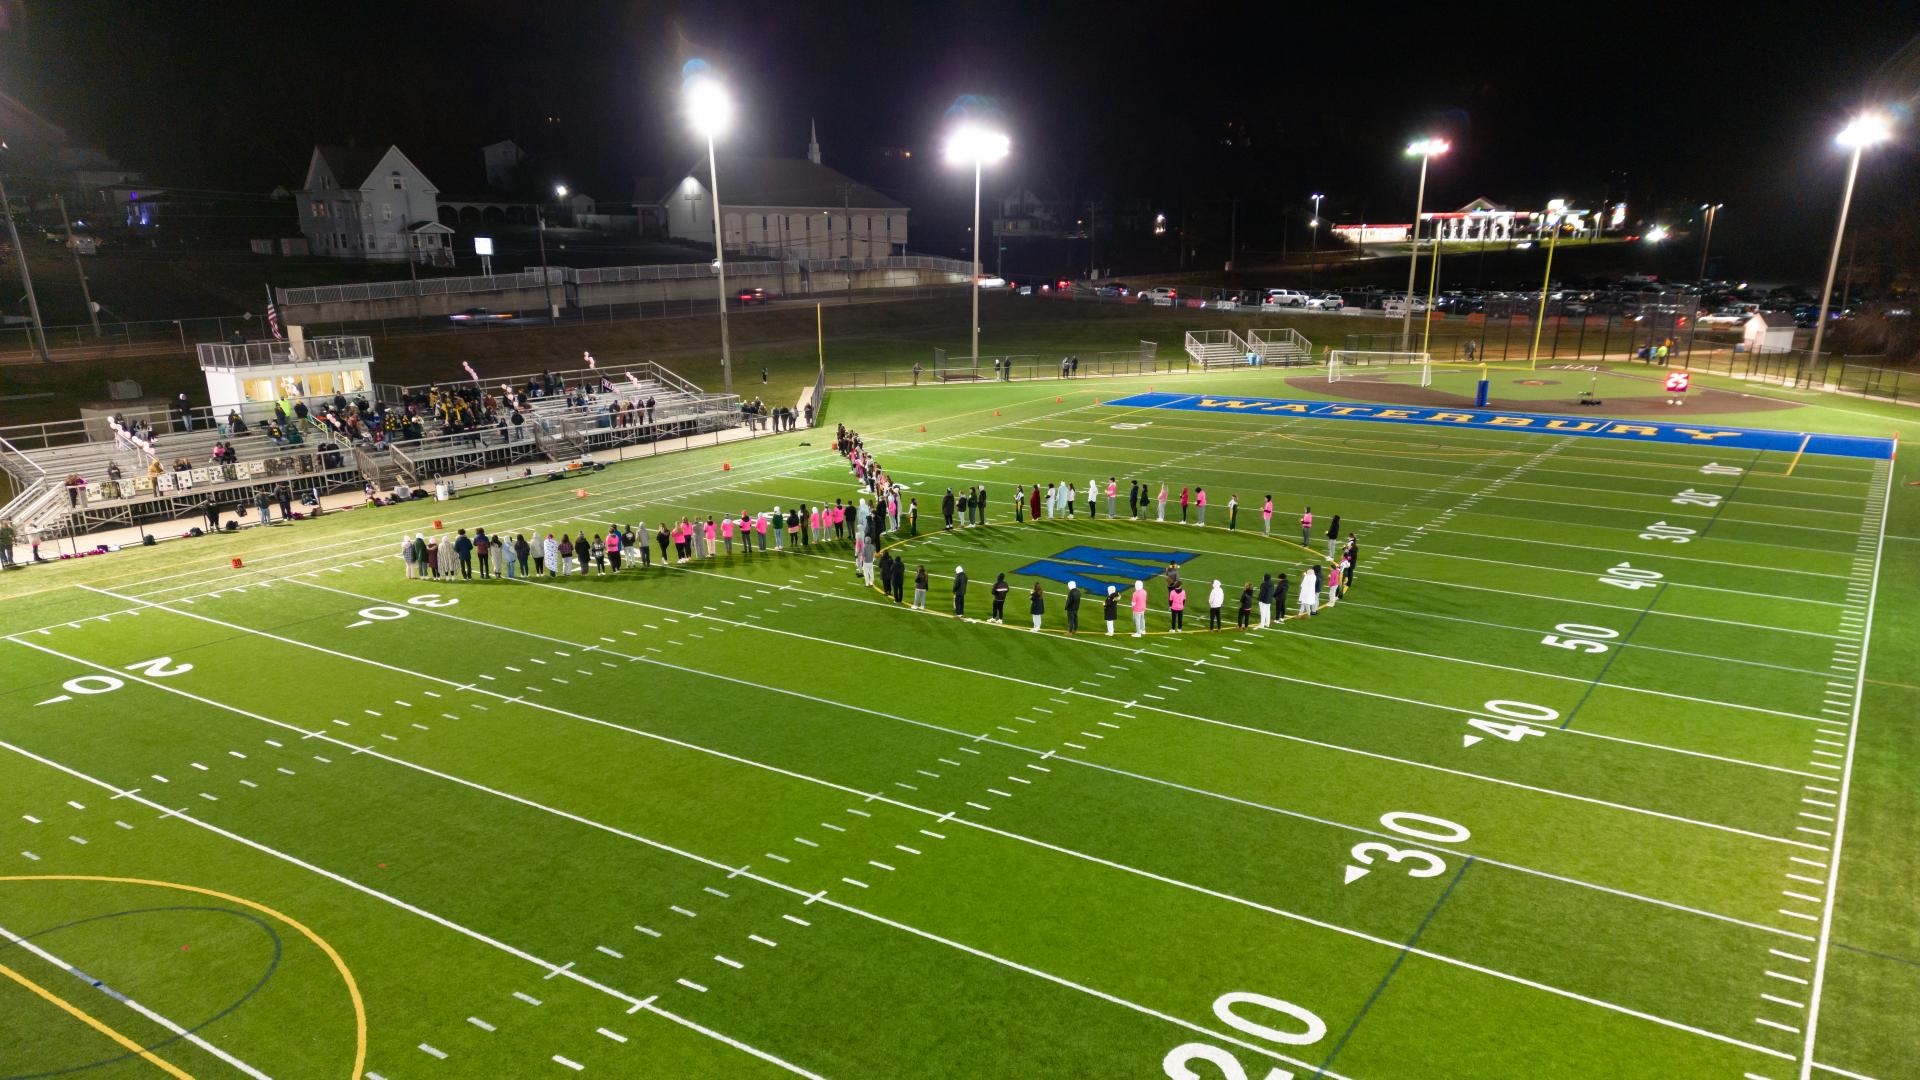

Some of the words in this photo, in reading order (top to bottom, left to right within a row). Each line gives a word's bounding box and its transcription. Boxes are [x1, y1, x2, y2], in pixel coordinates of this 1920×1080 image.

[1667, 373, 1689, 388] 25
[1199, 398, 1743, 440] WATERBURY
[956, 458, 1008, 470] 30
[1698, 464, 1744, 476] 10
[1670, 491, 1723, 508] 20
[1638, 524, 1697, 544] 30
[1598, 567, 1664, 590] 40
[357, 593, 459, 621] 30
[1541, 623, 1620, 653] 50
[62, 656, 194, 695] 20
[1467, 700, 1560, 742] 40
[1350, 811, 1472, 878] 30
